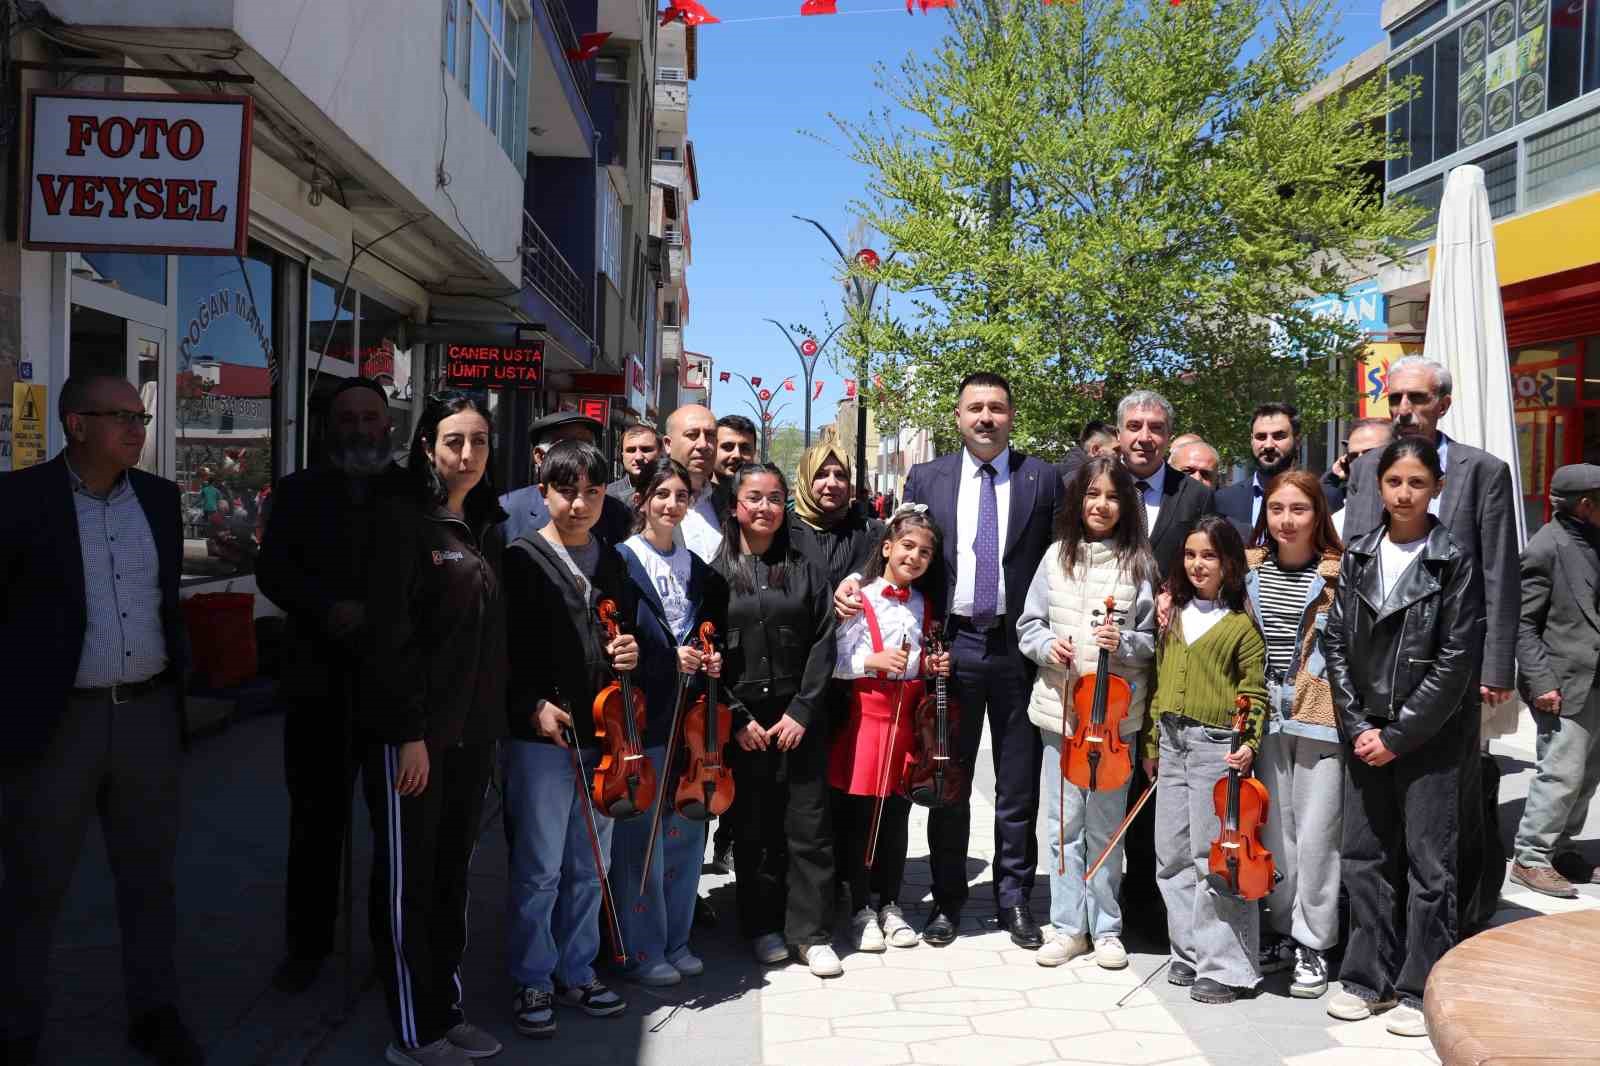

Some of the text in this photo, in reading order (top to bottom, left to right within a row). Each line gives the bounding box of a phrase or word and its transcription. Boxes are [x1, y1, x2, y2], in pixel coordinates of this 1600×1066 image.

[66, 115, 204, 161] FOTO
[37, 174, 228, 222] VEYSEL
[449, 346, 542, 362] CANER USTA
[495, 365, 537, 381] USTA
